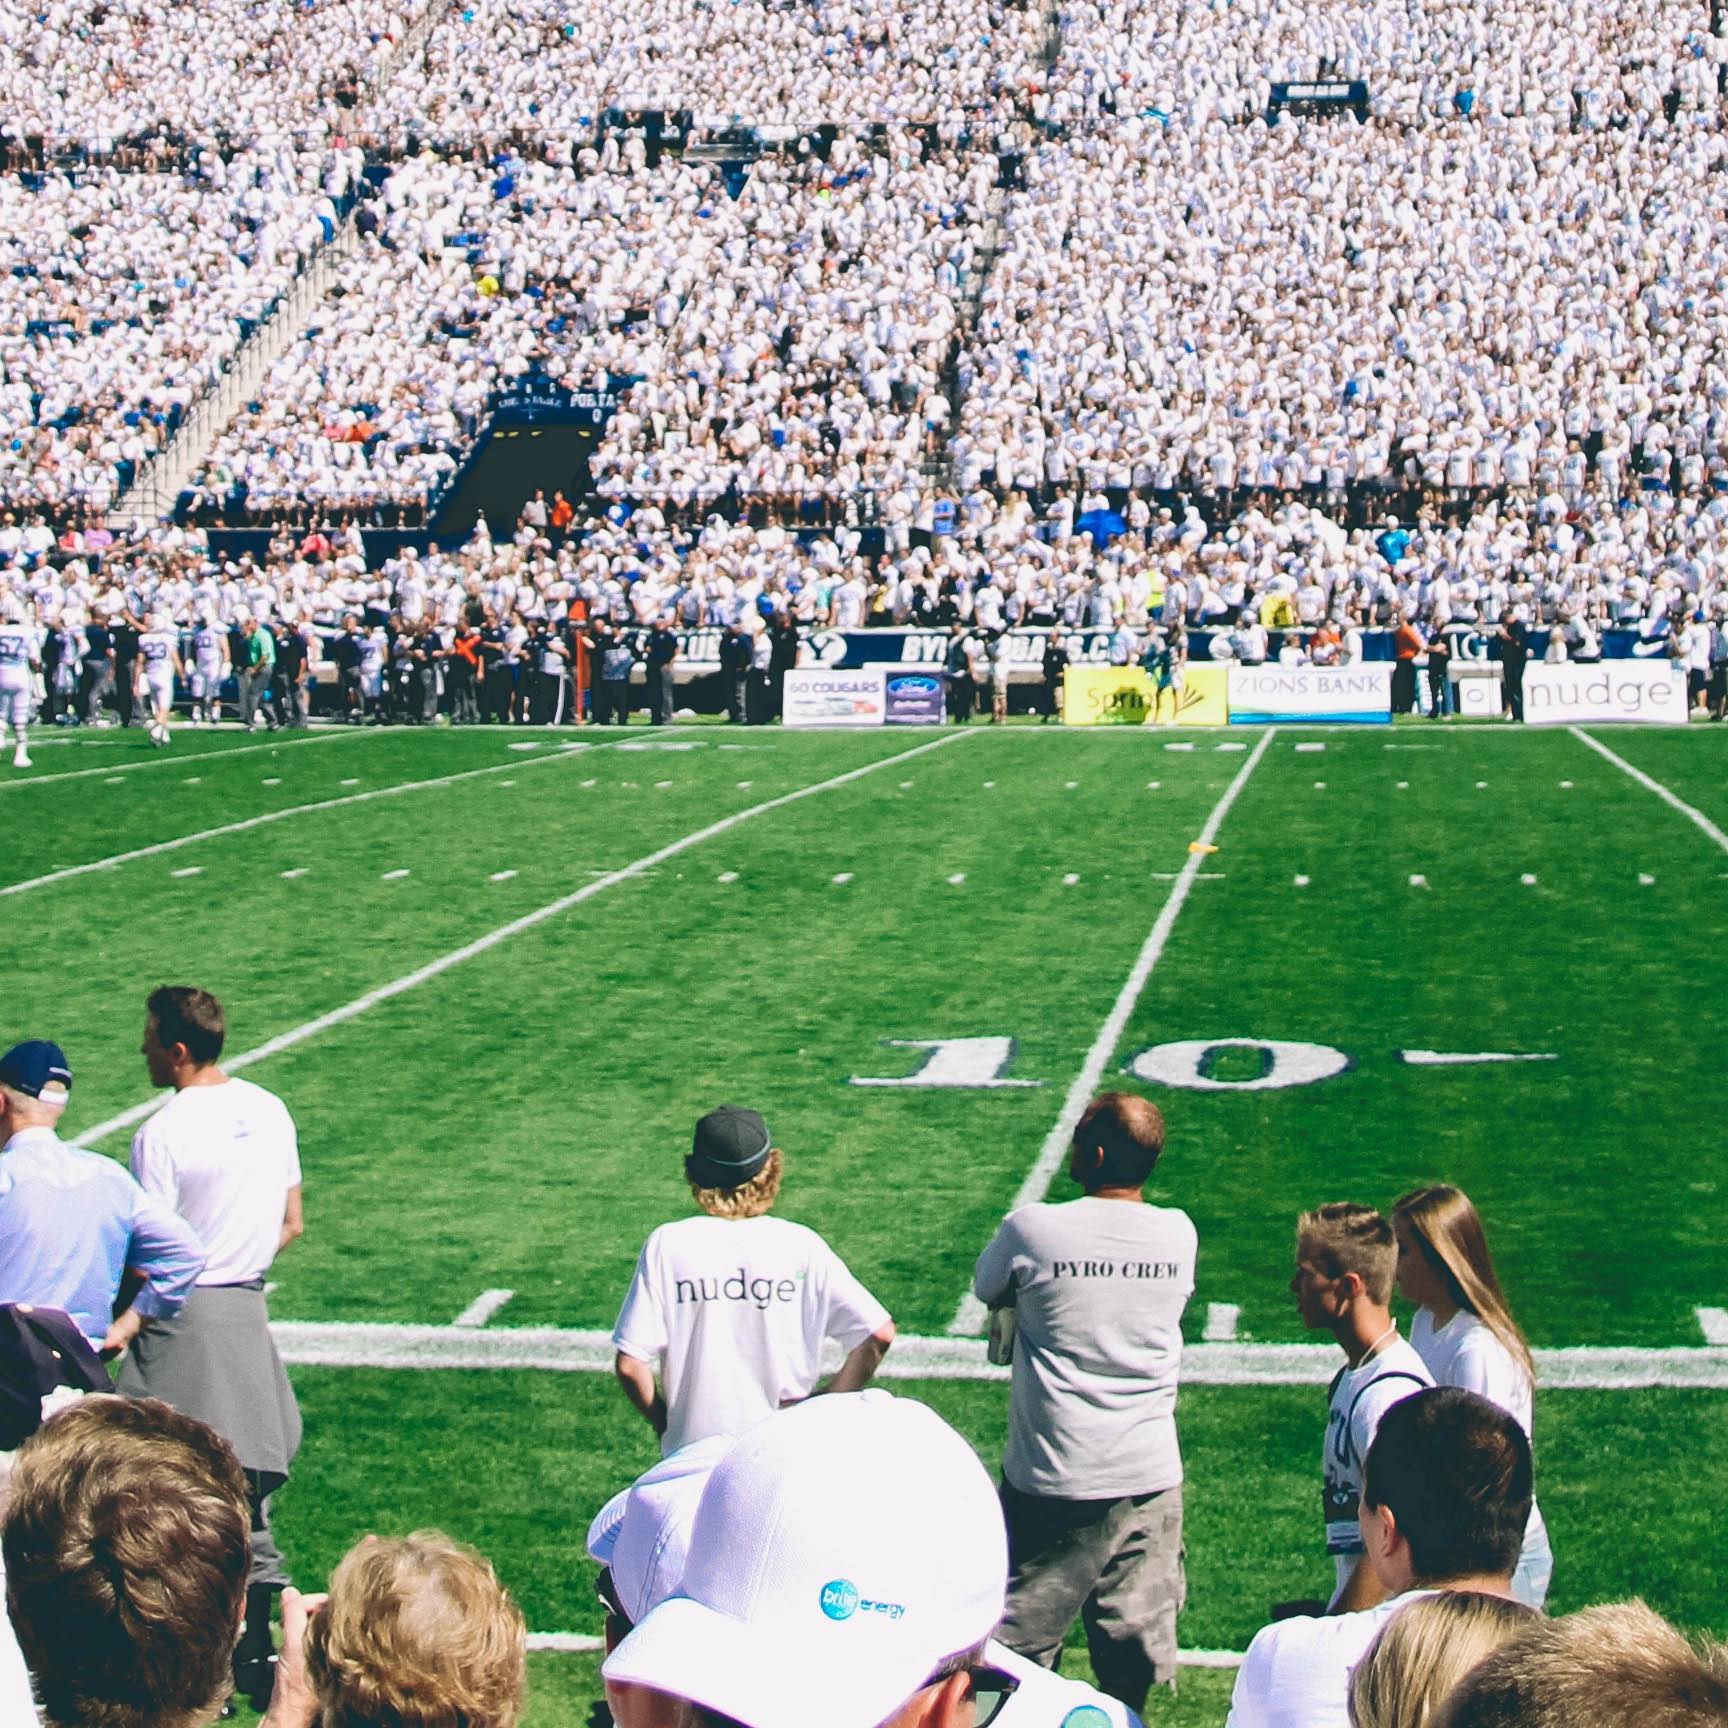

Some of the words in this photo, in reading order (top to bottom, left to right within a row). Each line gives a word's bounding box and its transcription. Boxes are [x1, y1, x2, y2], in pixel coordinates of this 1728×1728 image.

[813, 680, 880, 694] COUGARS
[1236, 676, 1307, 694] ZIONS
[1317, 674, 1382, 693] BANK
[1528, 673, 1672, 712] nudge
[1053, 1261, 1114, 1279] PYRO
[1122, 1261, 1181, 1279] CREW
[675, 1268, 796, 1310] nudge
